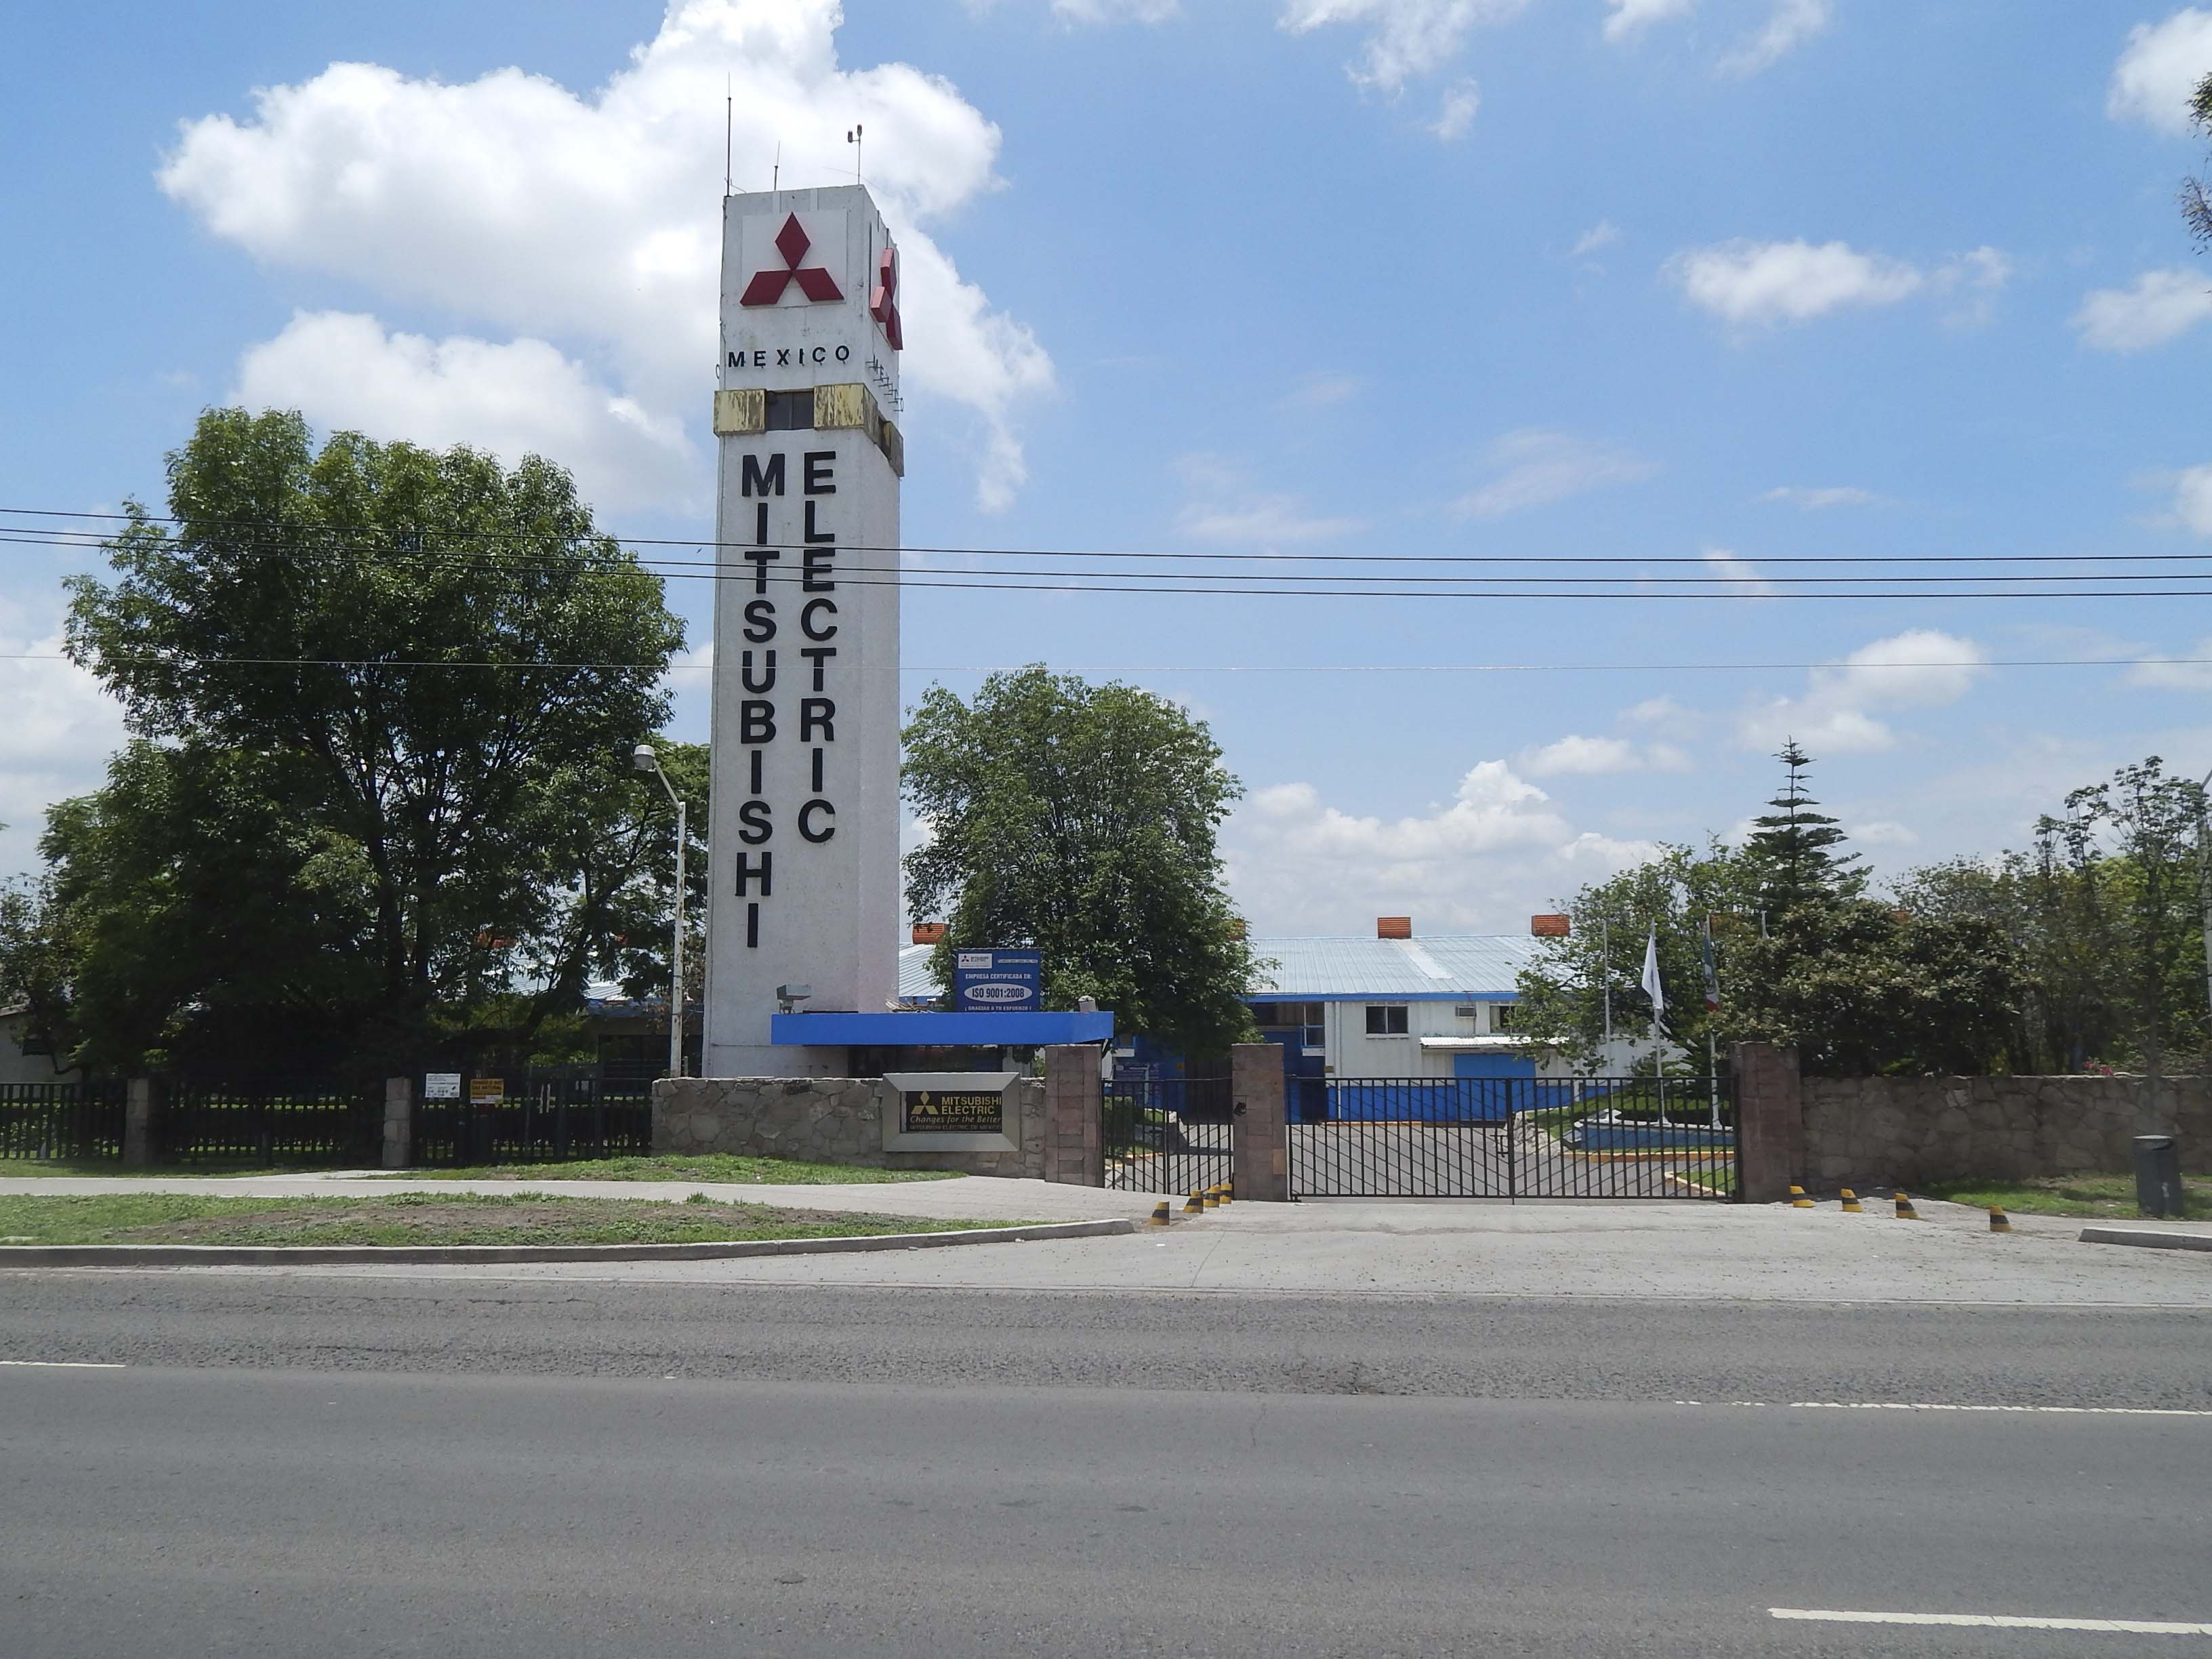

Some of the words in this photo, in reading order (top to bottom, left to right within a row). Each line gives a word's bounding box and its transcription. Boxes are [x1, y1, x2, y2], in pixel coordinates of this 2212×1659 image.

[728, 345, 850, 368] MEXICO
[798, 451, 838, 844] ELECTRIC
[735, 453, 785, 949] MITSUBISHI
[972, 988, 984, 998] ISO
[986, 988, 1025, 998] 9001:2008
[941, 1097, 1002, 1105] MITSUBISHI
[941, 1105, 995, 1115] ELECTRIC
[910, 1115, 945, 1124] Changes
[947, 1115, 959, 1124] for
